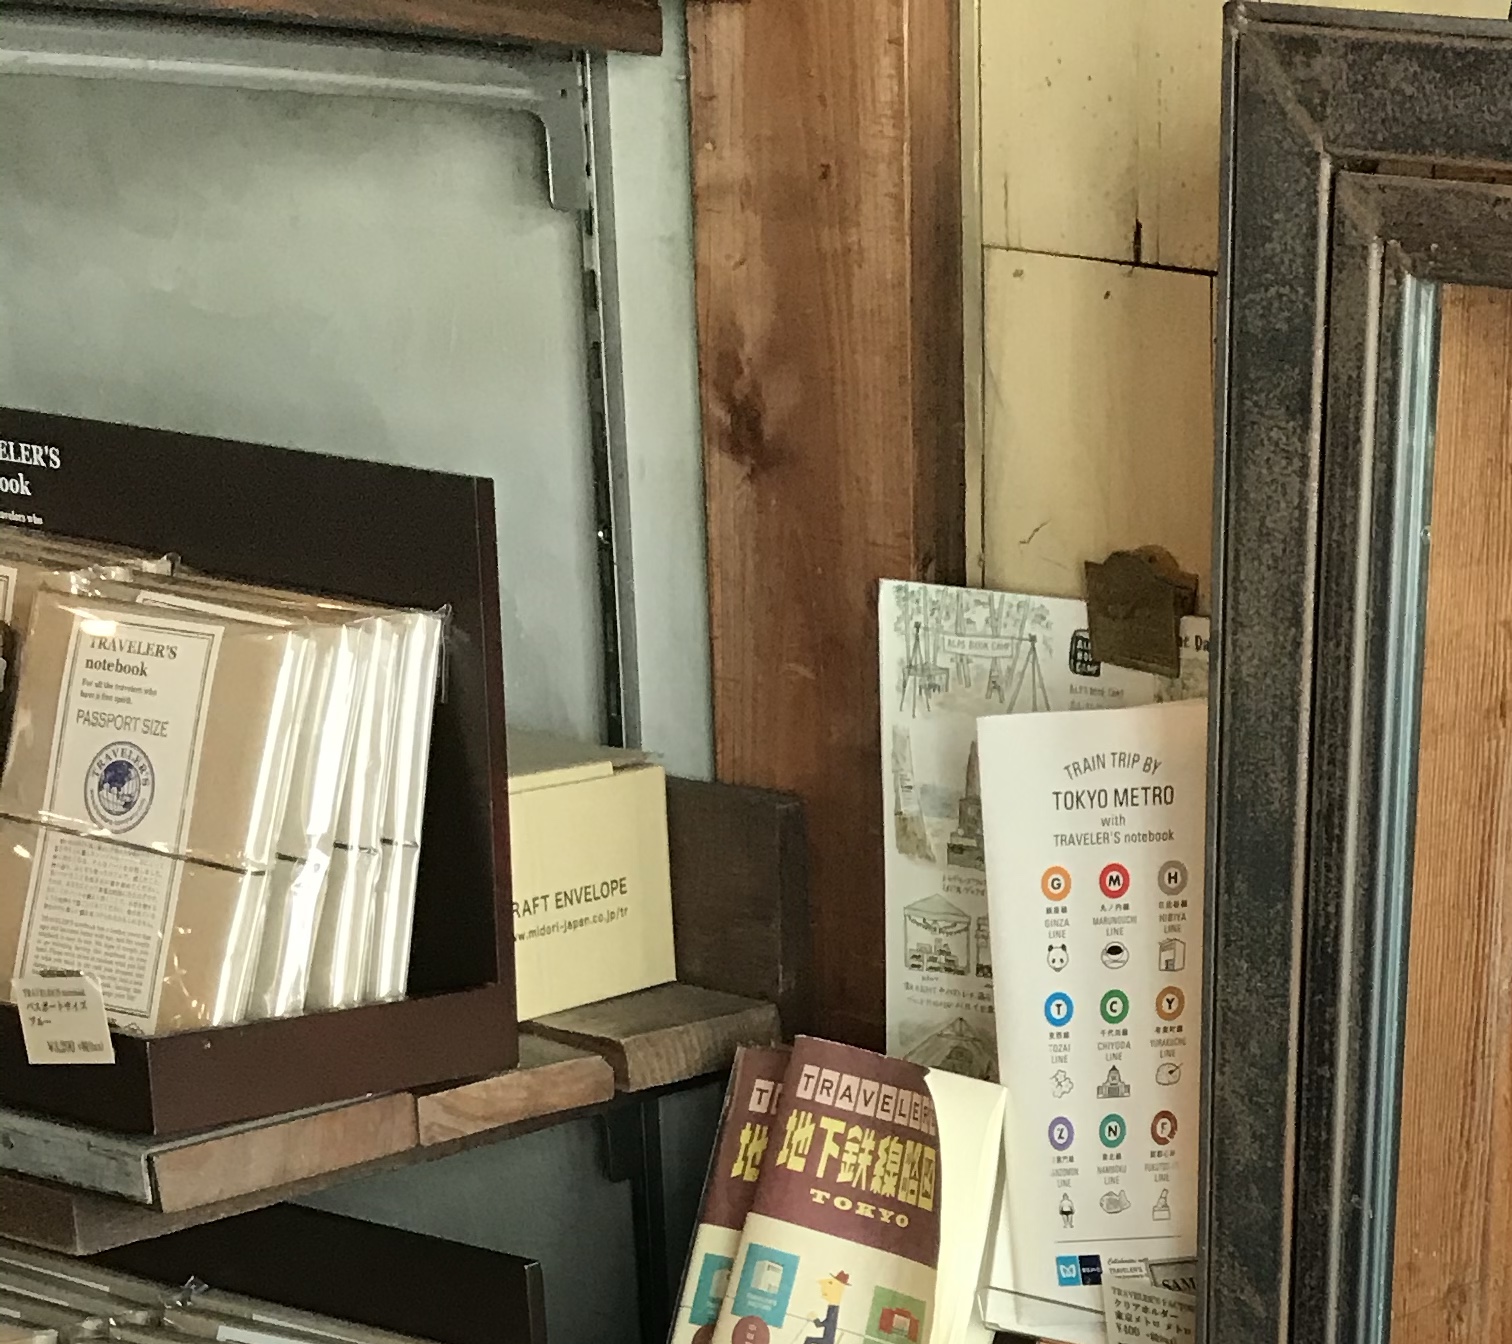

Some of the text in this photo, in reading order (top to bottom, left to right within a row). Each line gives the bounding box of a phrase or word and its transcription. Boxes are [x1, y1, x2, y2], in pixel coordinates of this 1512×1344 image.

[89, 636, 178, 660] TRAVELER'S
[85, 658, 148, 677] notebook
[76, 709, 169, 738] PASSPORT SIZE
[1063, 752, 1162, 780] TRAIN TRIP BY
[1052, 785, 1174, 811] TOKYO METRO
[1101, 814, 1125, 826] with
[1053, 829, 1174, 847] TRAVELER'S notebook
[554, 877, 628, 909] ENVELOPE
[809, 1188, 909, 1228] TOKYO
